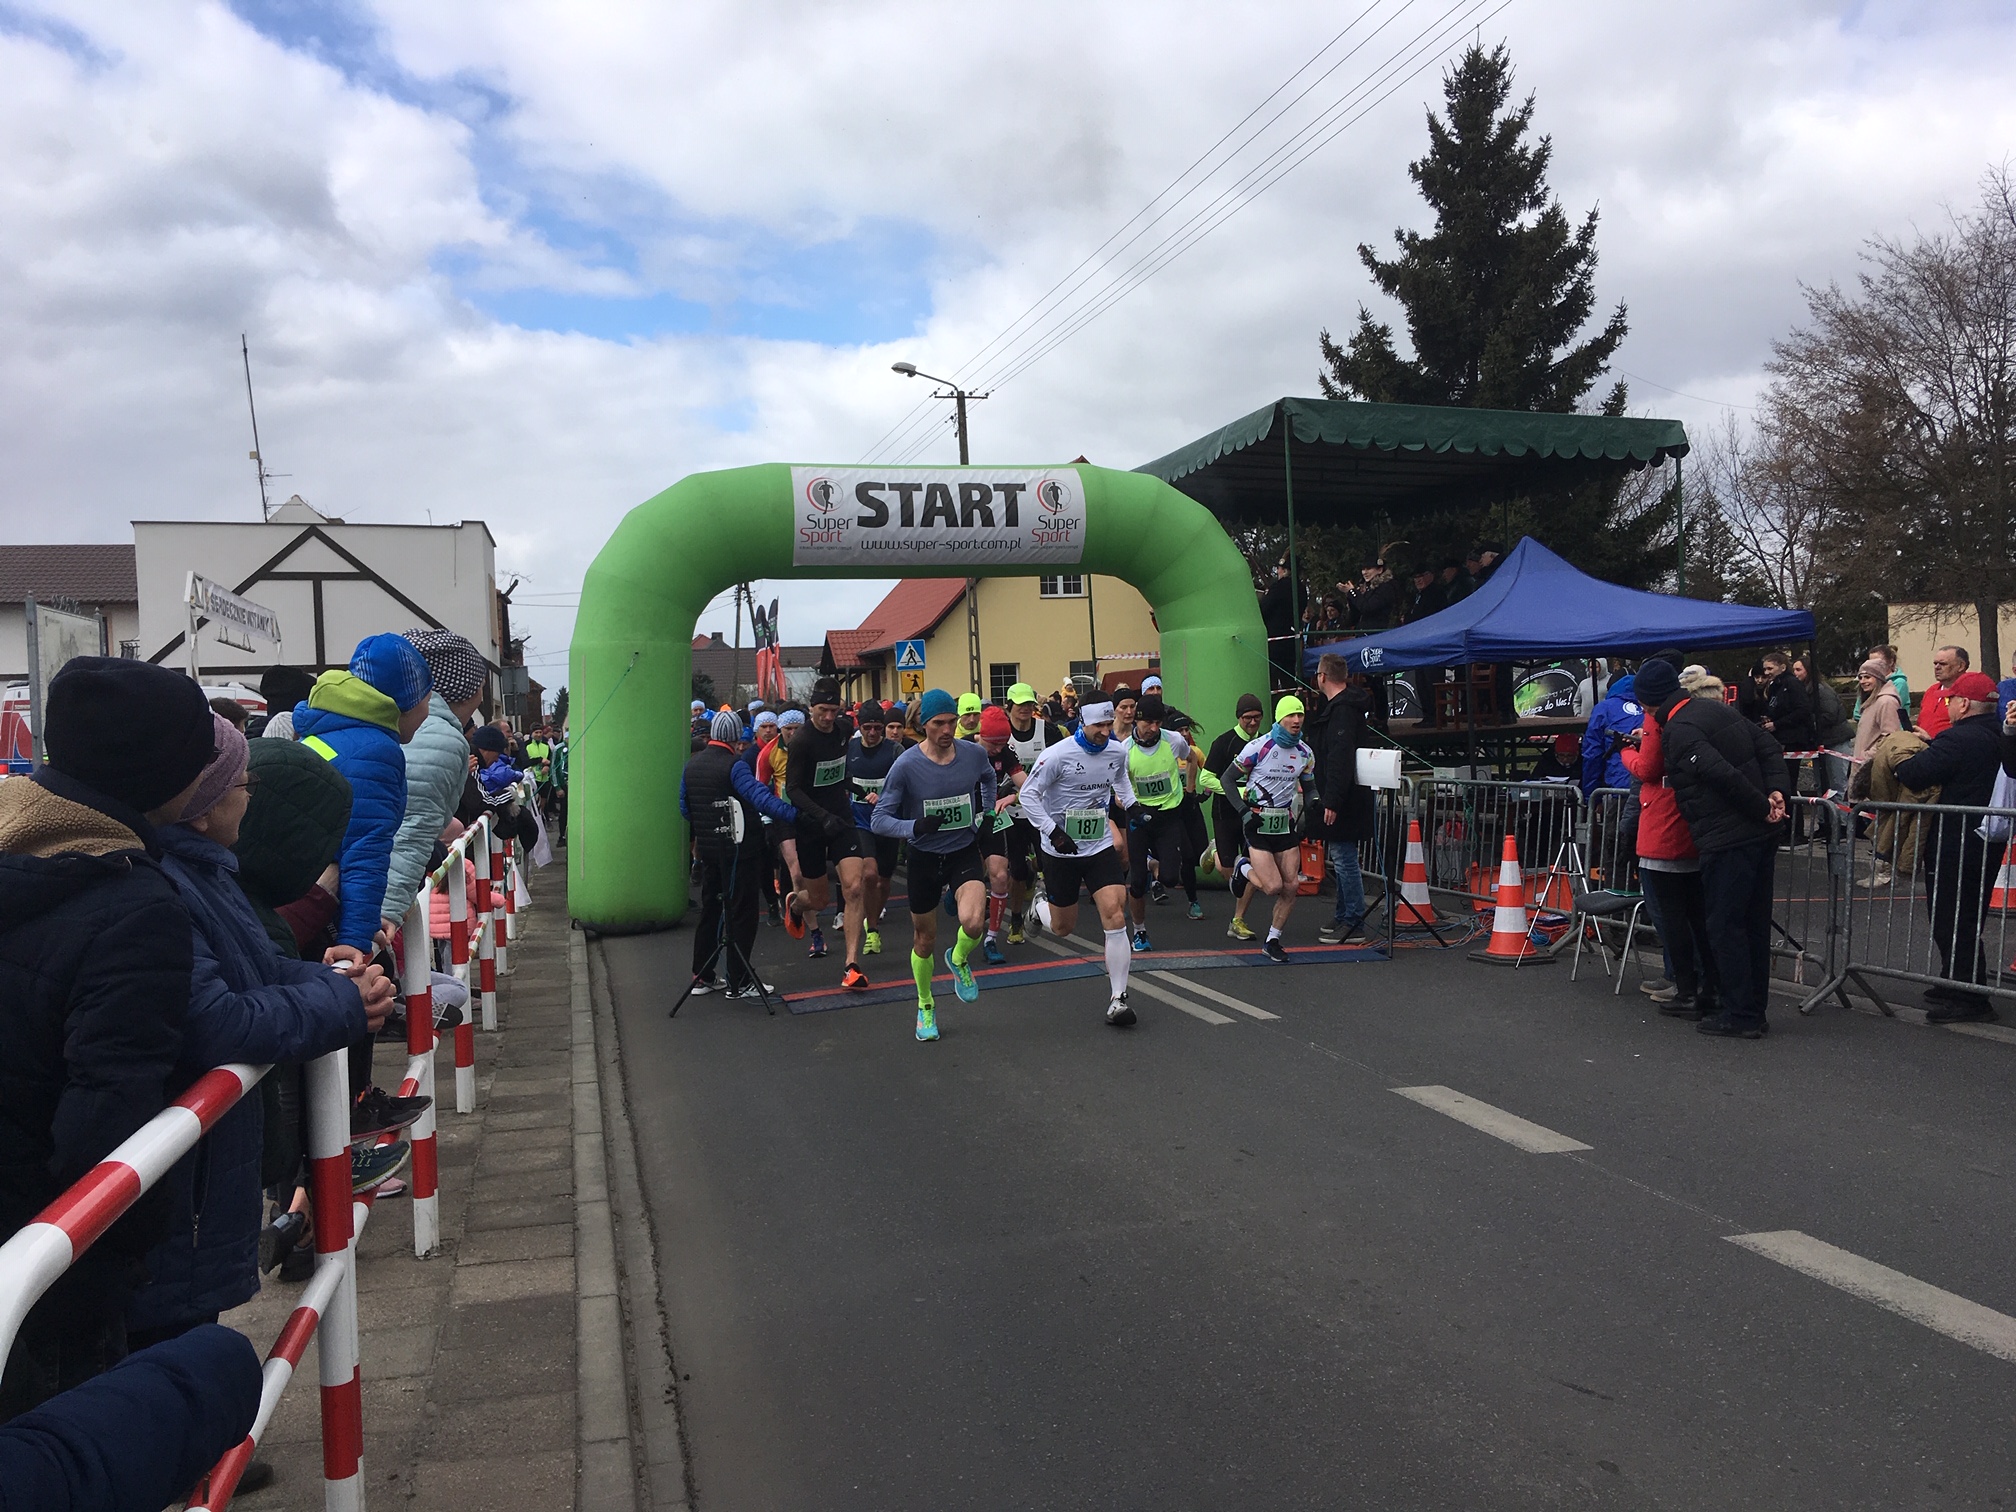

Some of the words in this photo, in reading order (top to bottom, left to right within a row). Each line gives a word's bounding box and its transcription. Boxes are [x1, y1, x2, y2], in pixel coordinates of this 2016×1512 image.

[855, 481, 1026, 528] START
[806, 513, 853, 531] Super
[1037, 514, 1081, 532] Super
[799, 528, 843, 547] Sport
[860, 537, 1022, 552] www.super-sport.com.pl
[1031, 528, 1071, 546] Sport
[822, 765, 841, 781] 239
[1080, 783, 1110, 791] GARMIN
[1145, 780, 1165, 794] 120
[1077, 819, 1099, 835] 187
[1268, 815, 1285, 829] 131
